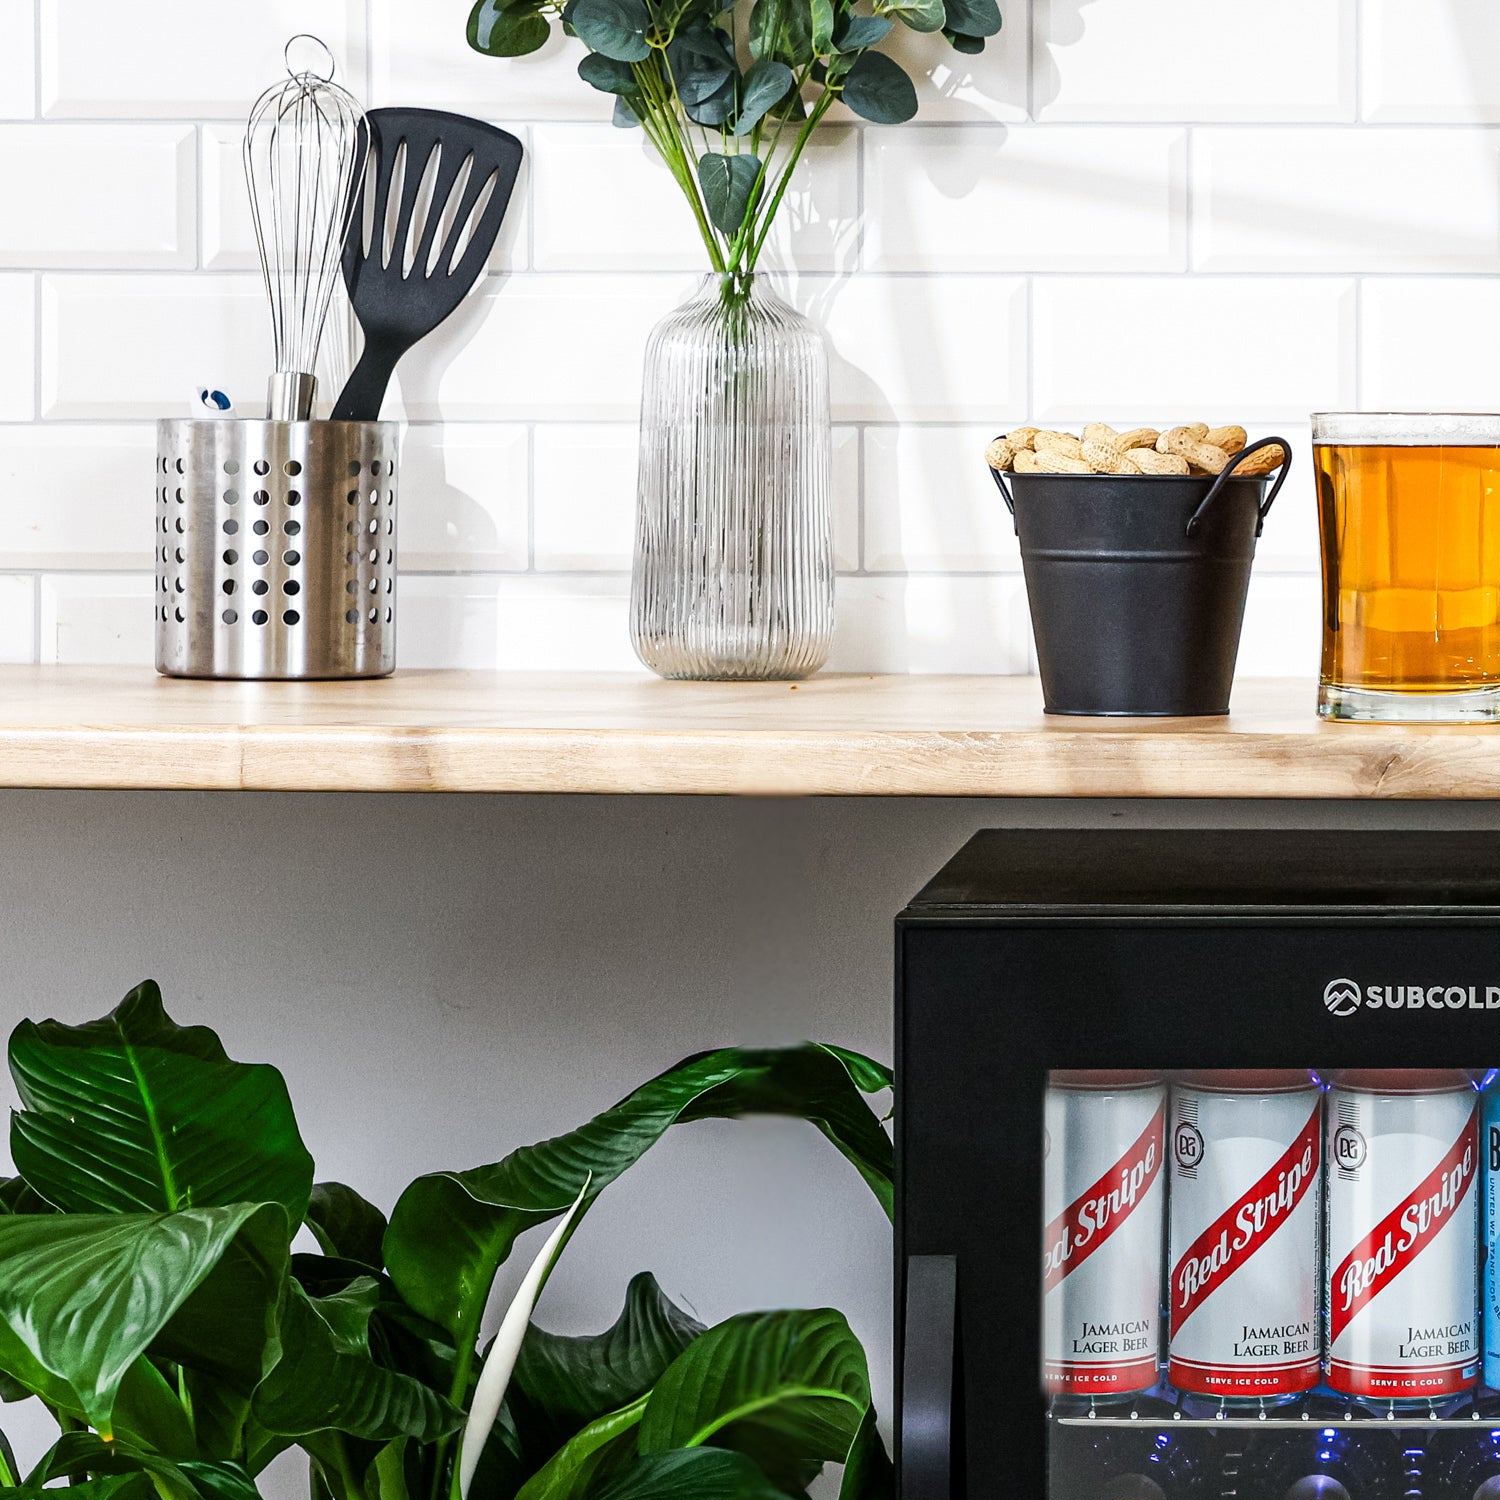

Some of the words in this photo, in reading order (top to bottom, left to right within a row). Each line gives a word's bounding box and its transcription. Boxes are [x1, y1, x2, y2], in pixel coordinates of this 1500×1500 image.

[1045, 1226, 1074, 1280] ed
[1073, 1141, 1157, 1248] Stripe
[1178, 1230, 1233, 1309] Red
[1232, 1145, 1313, 1251] Stripe
[1340, 1231, 1398, 1312] Red
[1396, 1145, 1472, 1253] Stripe
[1489, 1220, 1496, 1237] WE
[1093, 1374, 1118, 1382] COLD
[1205, 1376, 1232, 1385] SERVE
[1235, 1377, 1251, 1385] ICE
[1254, 1376, 1279, 1385] COLD
[1370, 1378, 1398, 1387] SERVE
[1401, 1379, 1417, 1387] ICE
[1420, 1377, 1444, 1386] COLD
